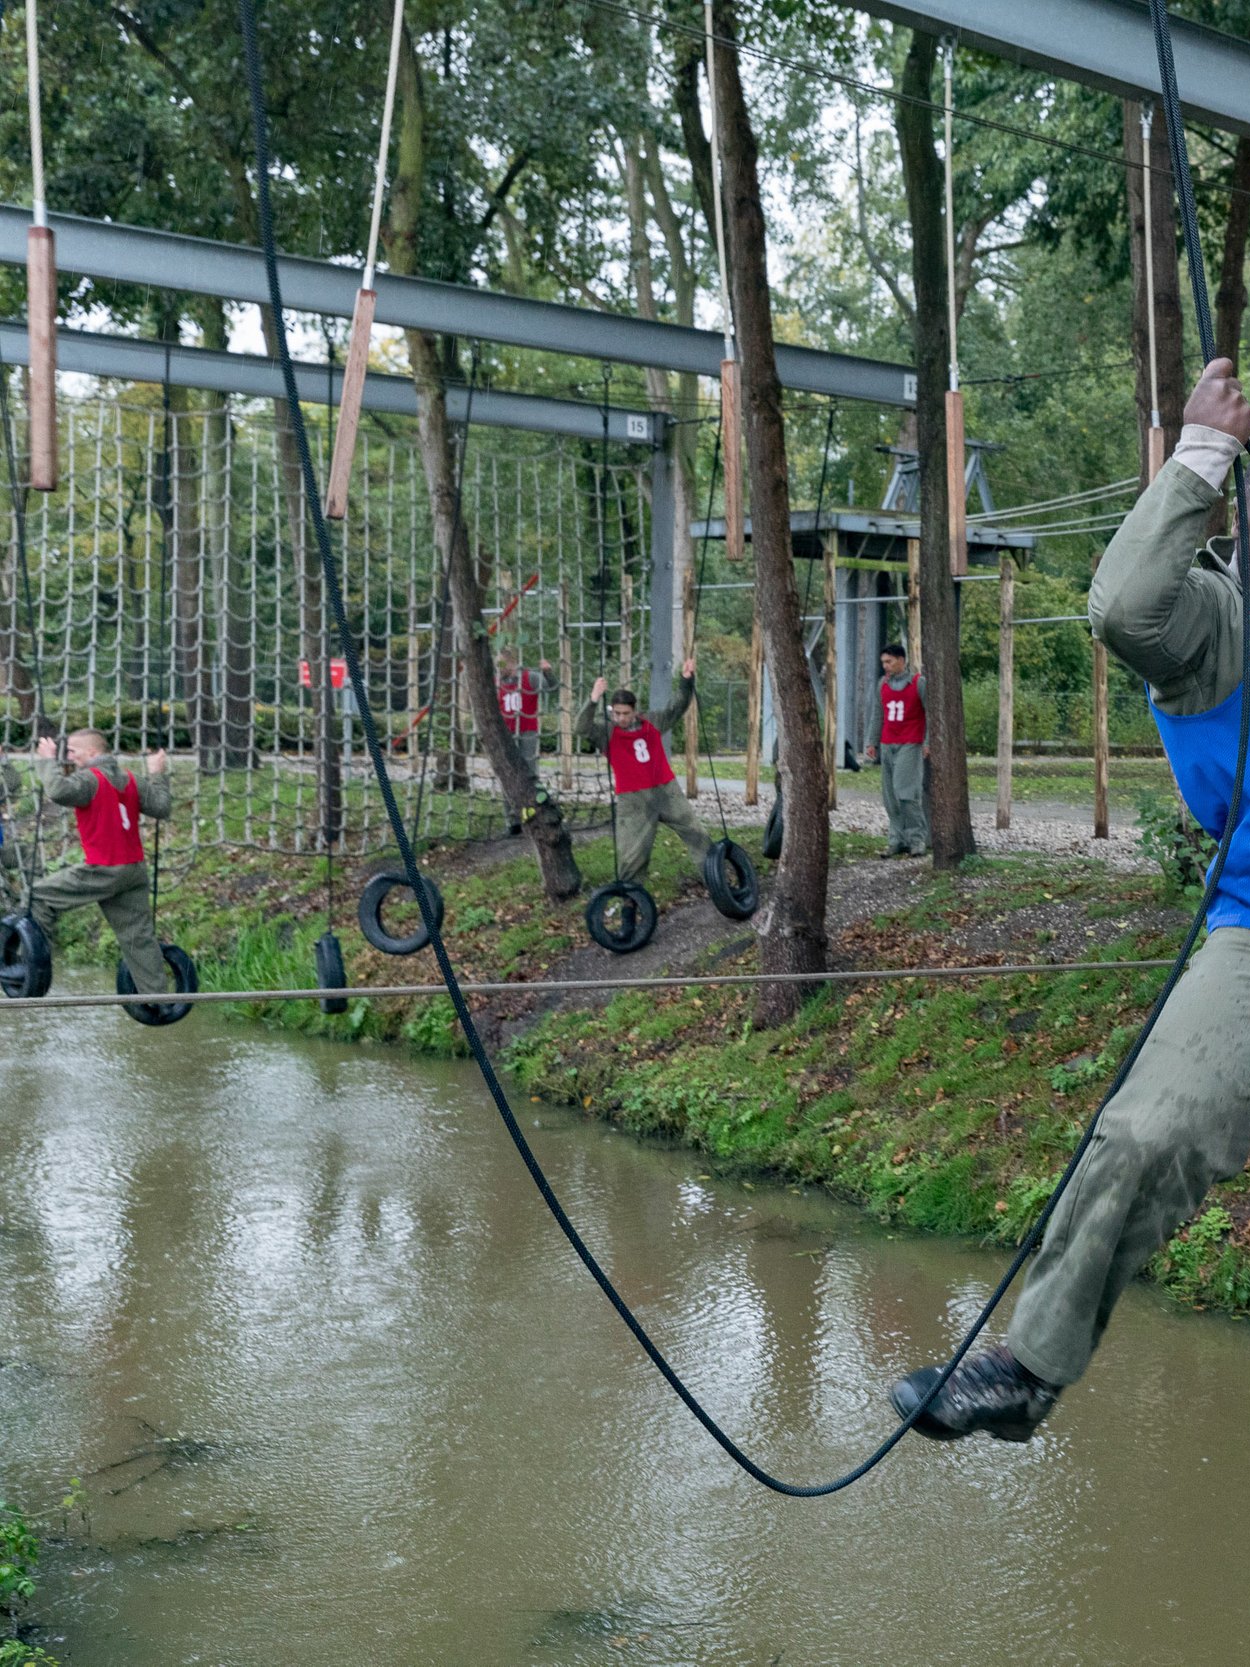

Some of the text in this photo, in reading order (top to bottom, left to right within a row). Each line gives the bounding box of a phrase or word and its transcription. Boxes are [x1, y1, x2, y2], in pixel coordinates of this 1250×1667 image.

[631, 420, 644, 433] 15
[502, 692, 522, 712] 10
[886, 700, 905, 721] 11
[633, 738, 650, 763] 8
